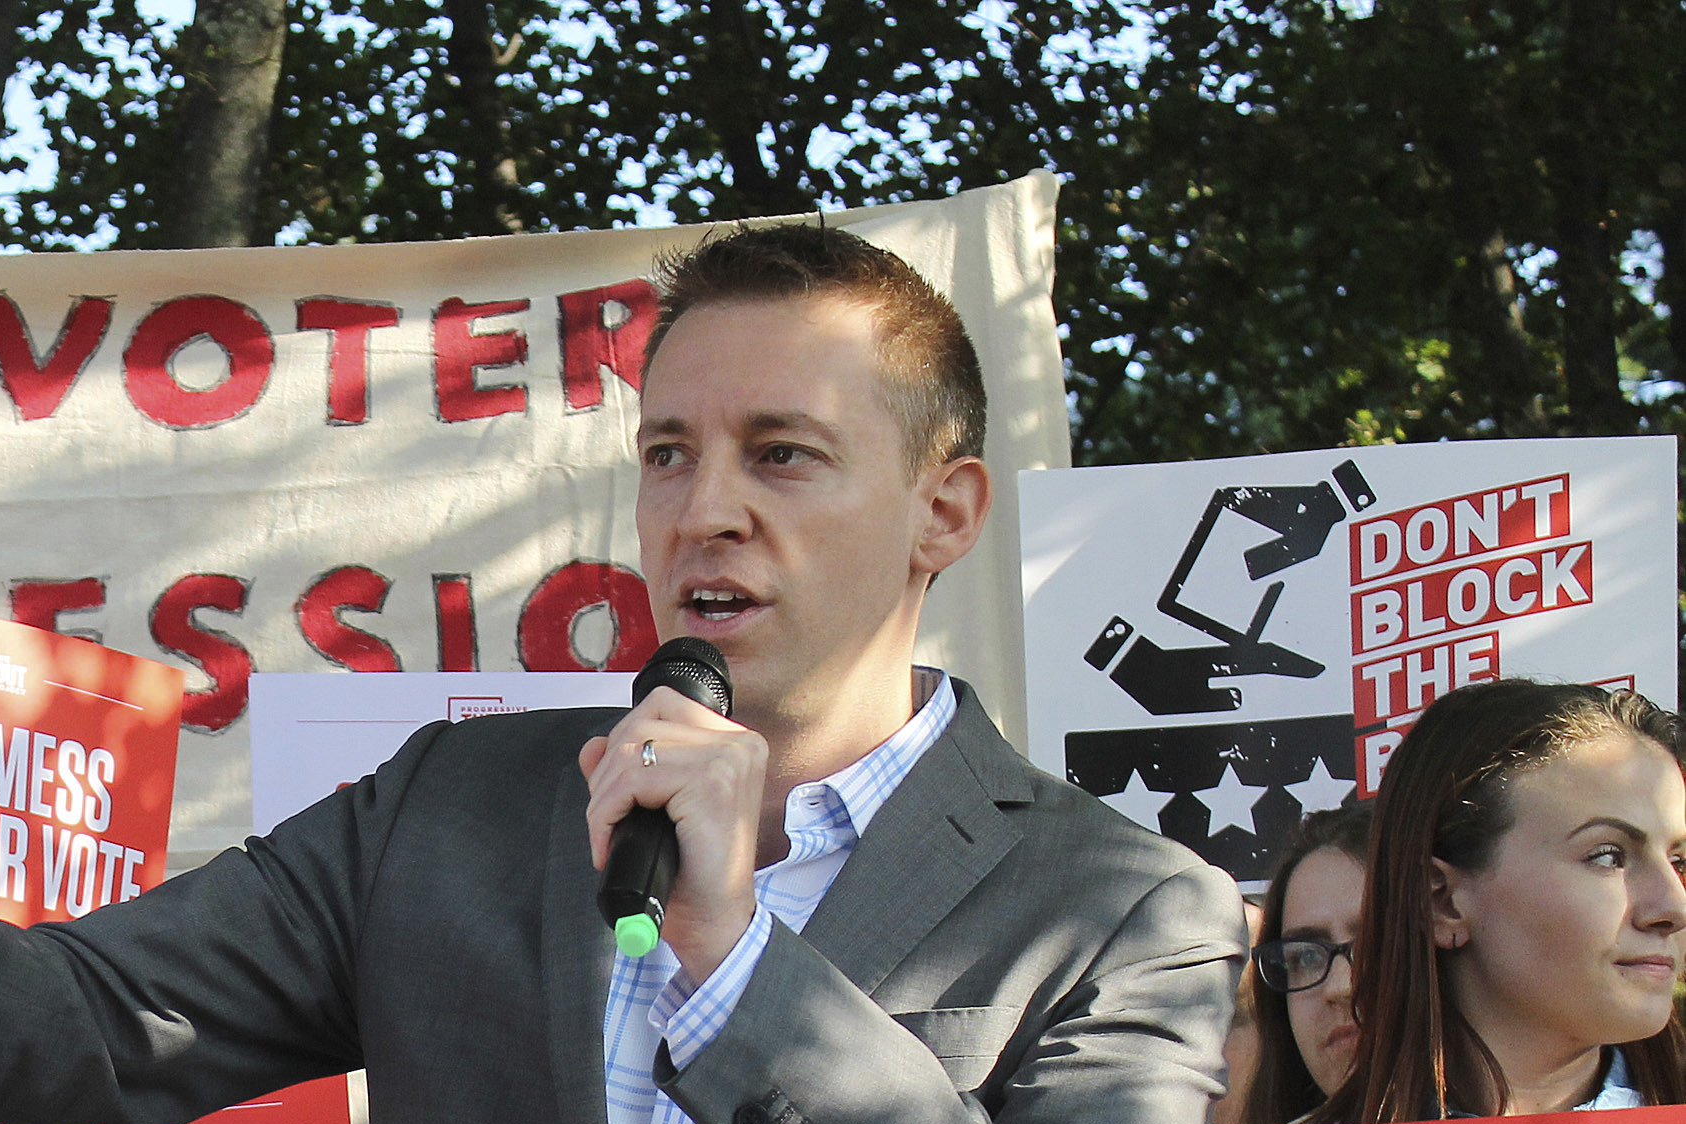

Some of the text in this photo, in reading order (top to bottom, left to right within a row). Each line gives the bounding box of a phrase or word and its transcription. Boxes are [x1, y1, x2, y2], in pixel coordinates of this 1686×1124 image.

[1359, 479, 1565, 574] DON'T
[1360, 550, 1589, 643] BLOCK
[1362, 634, 1495, 719] THE
[42, 823, 146, 918] VOTE
